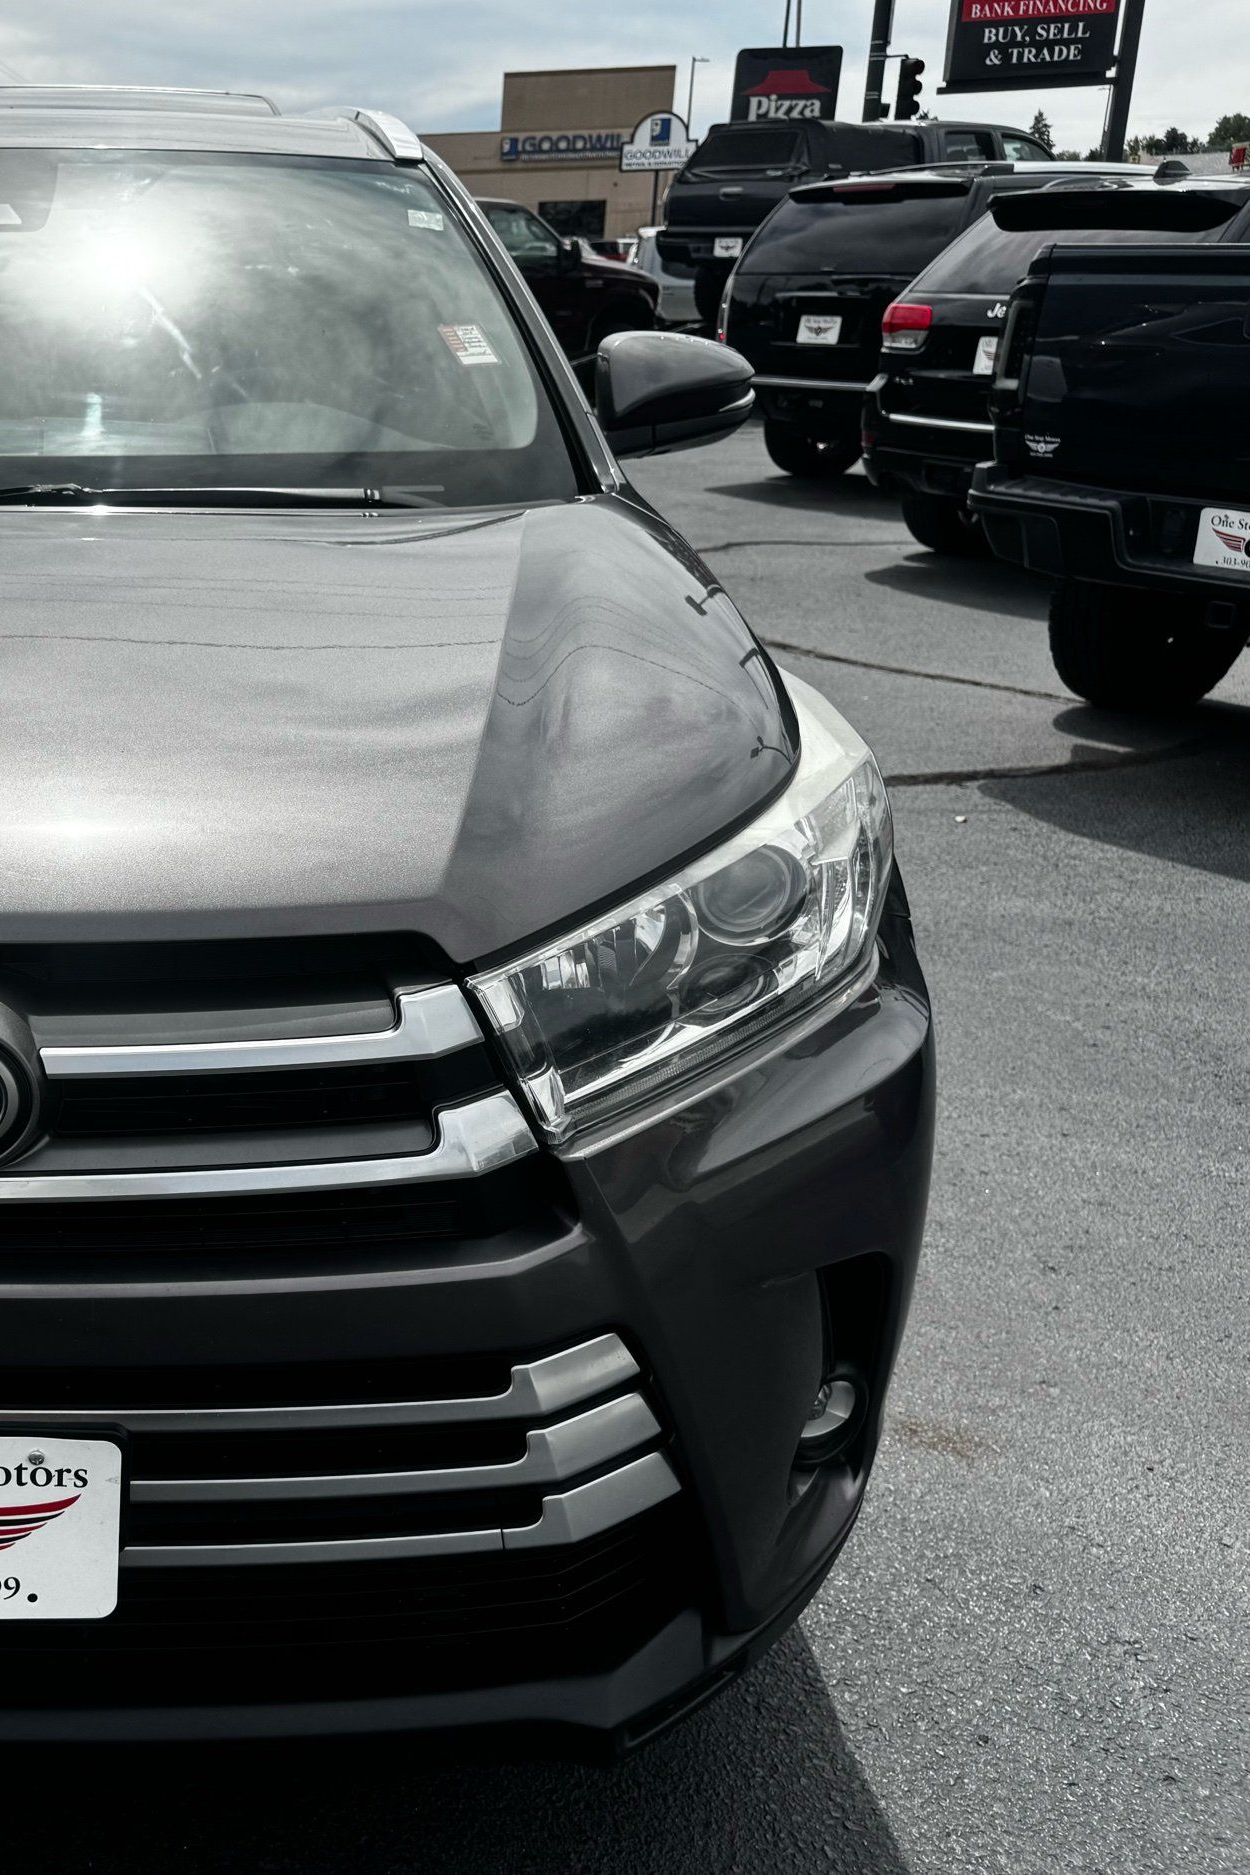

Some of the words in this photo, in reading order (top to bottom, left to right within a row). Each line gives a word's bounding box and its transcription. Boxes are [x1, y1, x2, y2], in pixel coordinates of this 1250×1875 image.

[971, 1, 1015, 18] BANK
[1019, 0, 1108, 15] FINANCING
[983, 25, 1030, 44] BUY,
[1035, 22, 1091, 40] SELL
[985, 50, 1002, 66] &
[1009, 44, 1082, 64] TRADE
[748, 94, 821, 121] Pizza
[522, 133, 622, 152] GOODWIL
[1211, 515, 1235, 528] One
